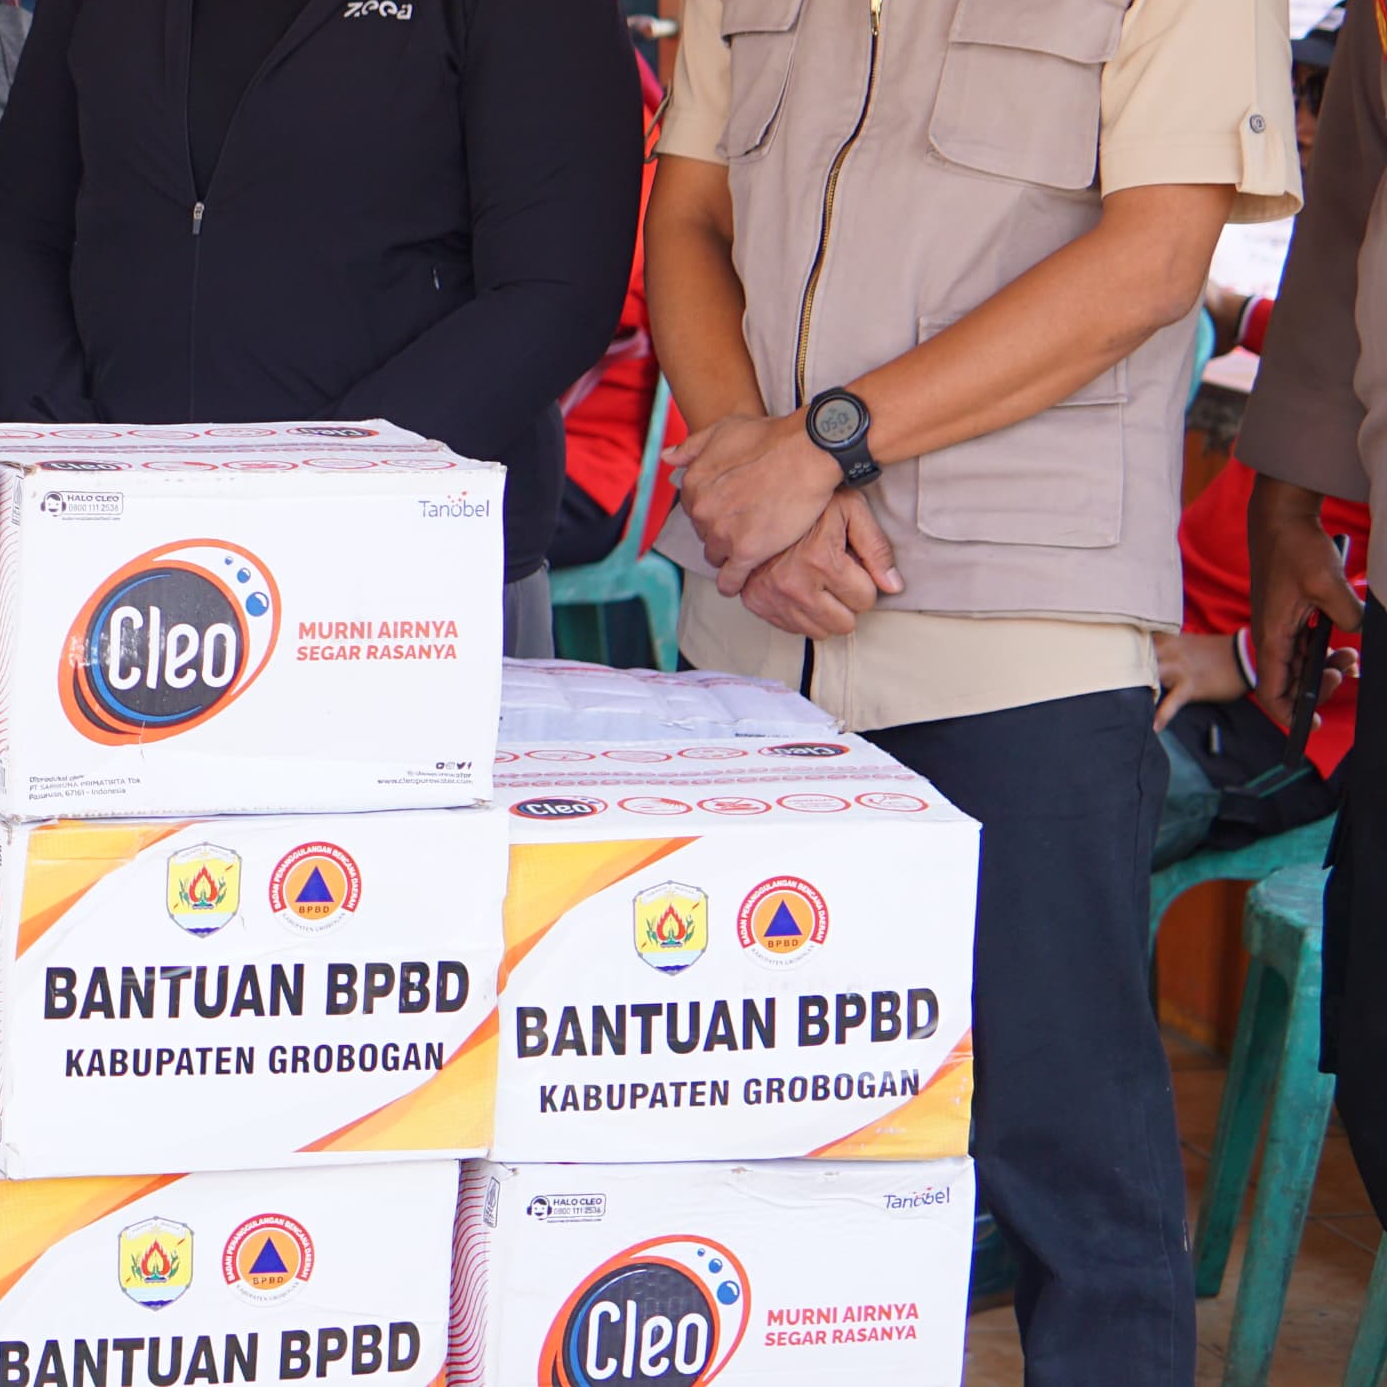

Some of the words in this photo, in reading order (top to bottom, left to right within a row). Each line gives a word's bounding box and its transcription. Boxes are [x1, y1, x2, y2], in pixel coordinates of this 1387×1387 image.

[298, 621, 373, 640] MURNI
[378, 620, 459, 639] AIRNYA
[108, 605, 237, 692] Cleo
[296, 645, 362, 662] SEGAR
[367, 643, 457, 660] RASANYA
[526, 801, 592, 816] Cleo
[298, 905, 330, 914] BPBD
[767, 939, 799, 948] BPBD
[44, 963, 304, 1020] BANTUAN
[327, 960, 470, 1016] BPBD
[516, 997, 776, 1059] BANTUAN
[797, 987, 940, 1047] BPBD
[65, 1046, 256, 1078] KABUPATEN
[267, 1042, 445, 1075] GROBOGAN
[539, 1079, 729, 1114] KABUPATEN
[743, 1068, 921, 1105] GROBOGAN
[553, 1198, 578, 1206] HALO
[579, 1197, 603, 1205] CLEO
[252, 1276, 284, 1285] BPBD
[766, 1309, 838, 1327] MURNI
[842, 1302, 919, 1324] AIRNYA
[587, 1300, 708, 1382] Cleo
[764, 1327, 827, 1346] SEGAR
[831, 1325, 917, 1344] RASANYA
[280, 1321, 422, 1380] BPBD
